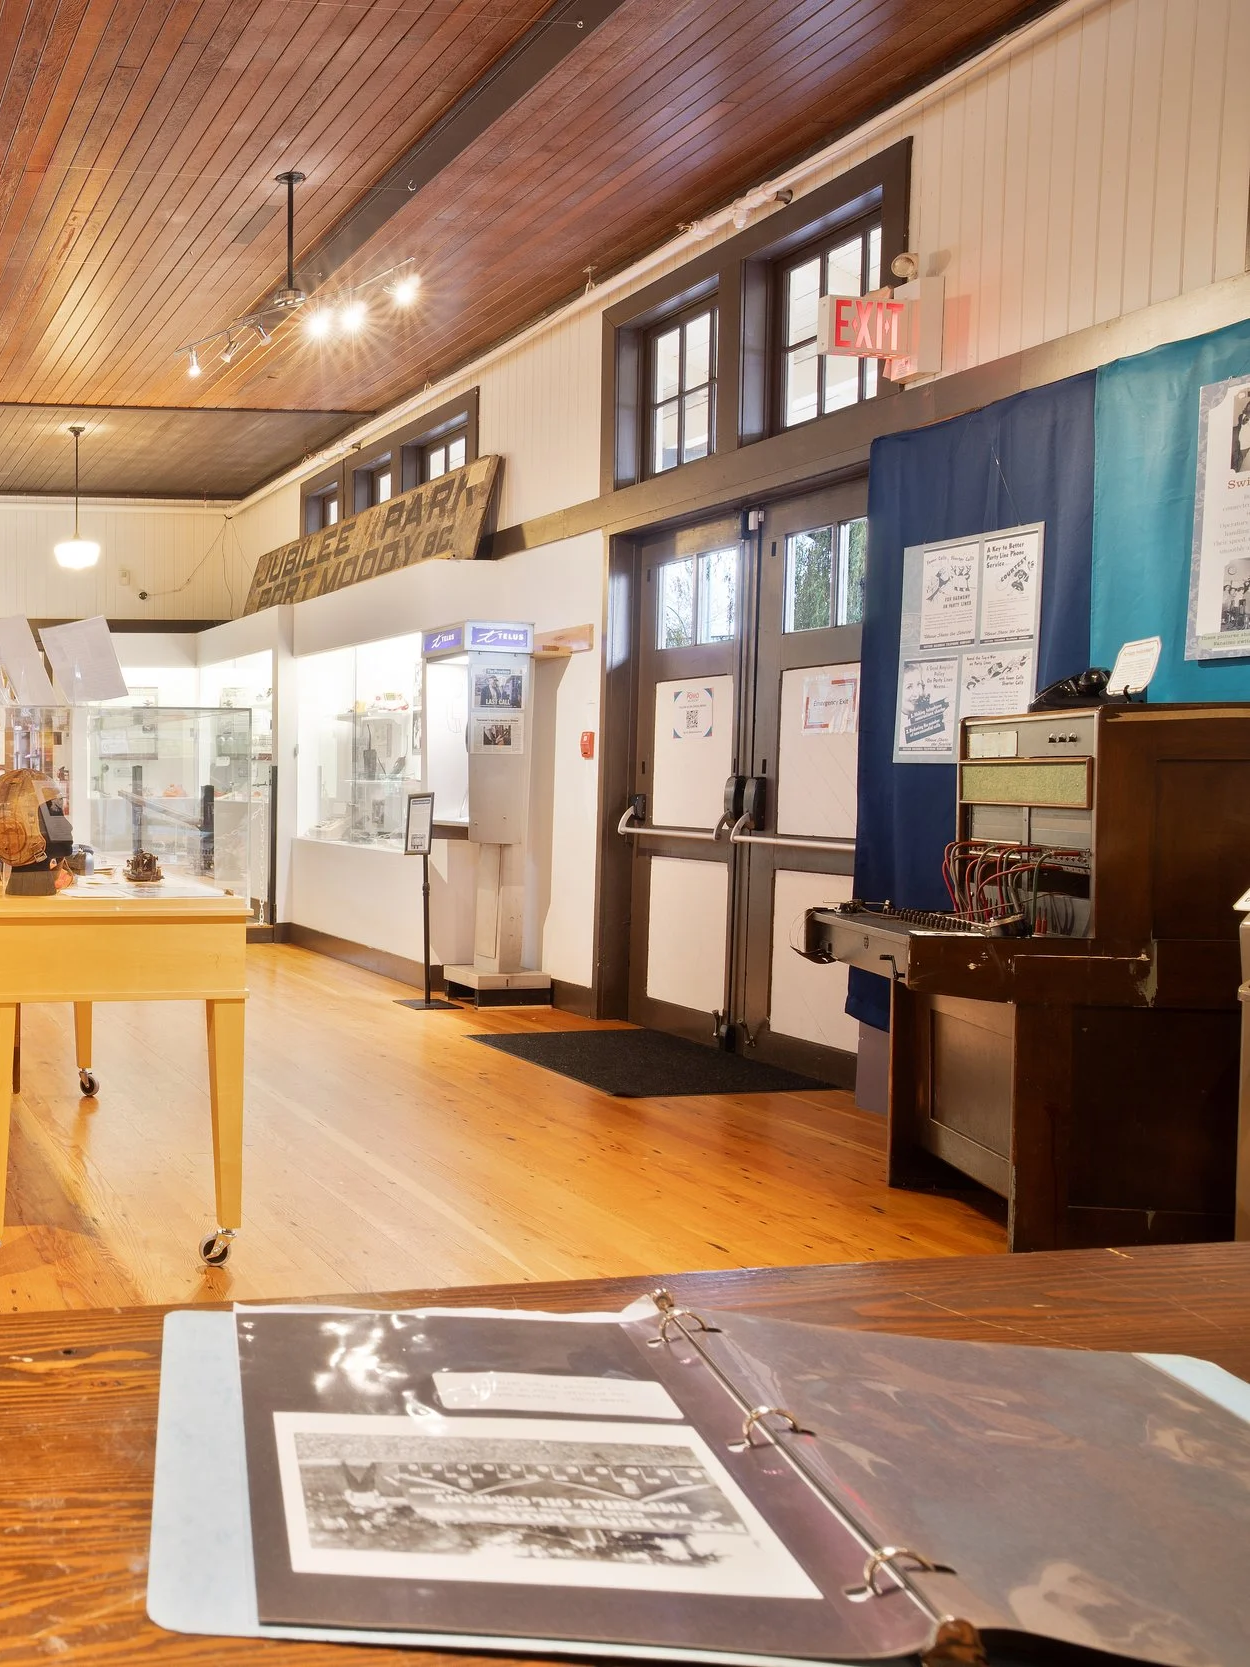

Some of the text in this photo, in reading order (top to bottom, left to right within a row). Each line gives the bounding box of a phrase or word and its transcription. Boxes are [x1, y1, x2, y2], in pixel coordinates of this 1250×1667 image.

[835, 299, 904, 350] EXIT
[256, 470, 474, 588] JUBILEE PARK
[256, 573, 321, 612] PORT
[318, 529, 424, 595] MOODY
[441, 633, 455, 643] TELUS
[498, 633, 524, 641] TELUS
[813, 699, 839, 707] Emergency
[434, 1494, 530, 1507] COMPANY
[531, 1497, 572, 1508] OIL
[573, 1499, 691, 1514] IMPERIAL
